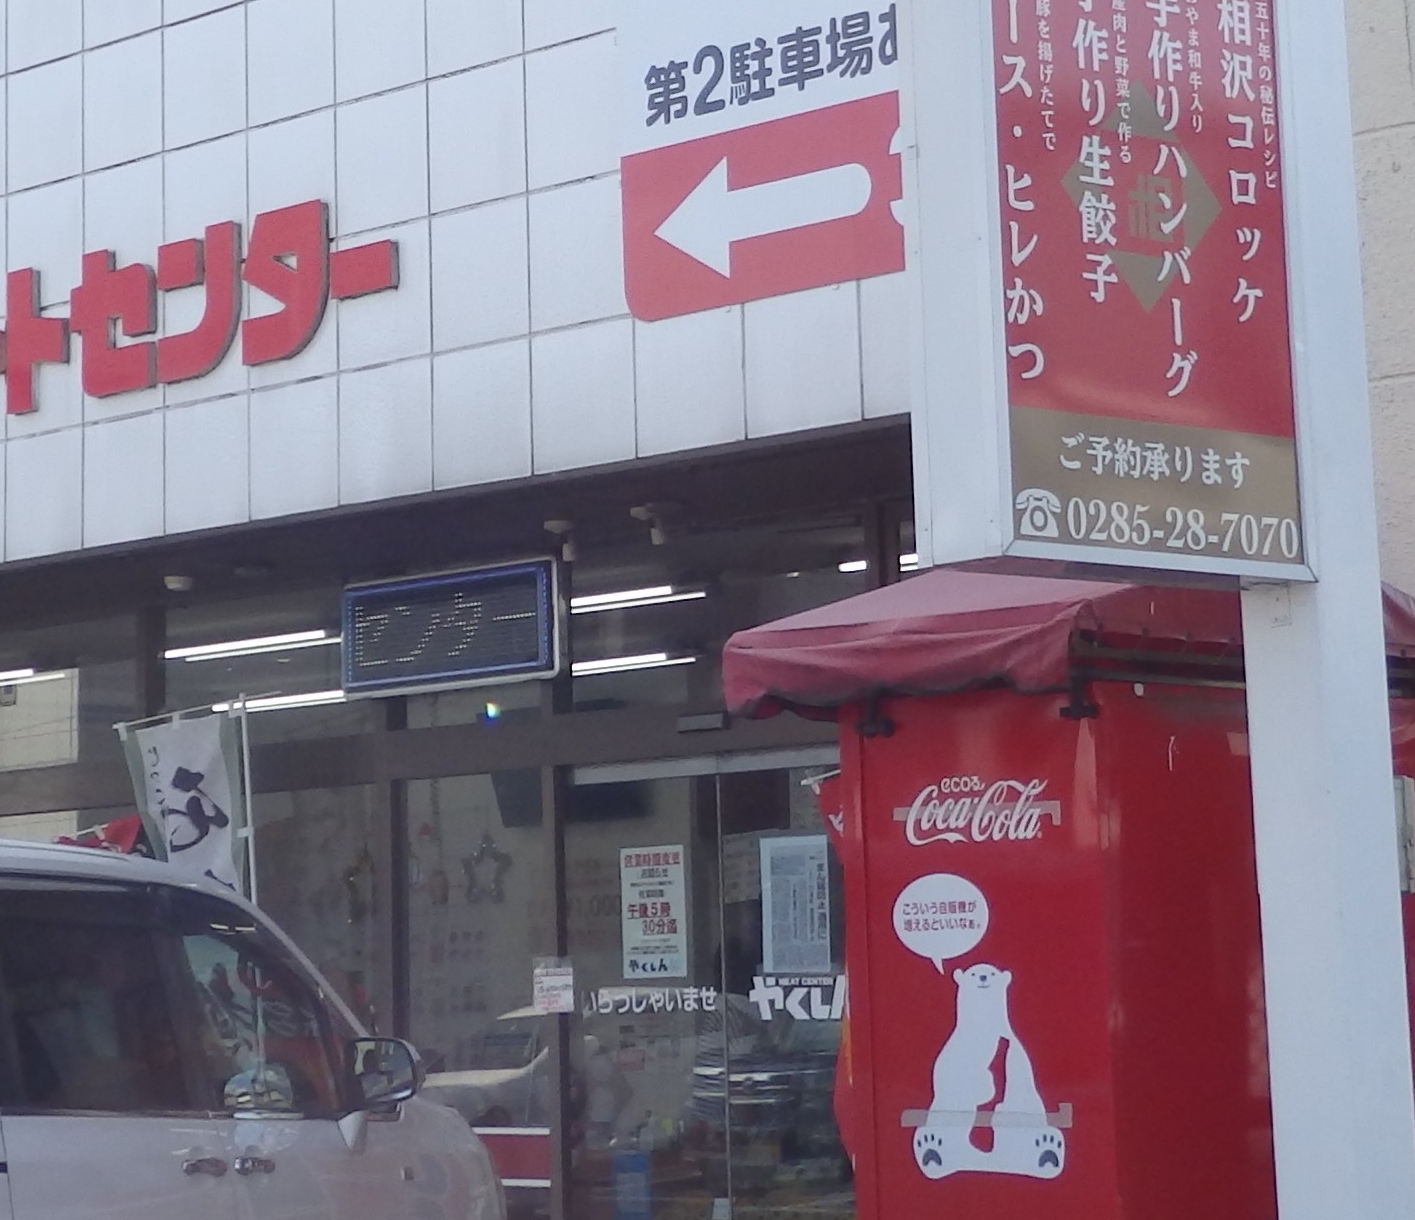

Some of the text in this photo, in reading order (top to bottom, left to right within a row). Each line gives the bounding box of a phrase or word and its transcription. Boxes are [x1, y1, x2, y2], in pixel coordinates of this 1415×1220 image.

[1255, 1, 1277, 189] 五十年の秘伝レシピ
[1059, 432, 1250, 488] ご予約承ります
[1066, 496, 1299, 558] 0285-28-7070
[906, 779, 1048, 846] Coca-Cola
[902, 900, 977, 916] こういう自販機が
[629, 957, 669, 973] やくしん
[582, 985, 717, 1014] いらっしゃいませ
